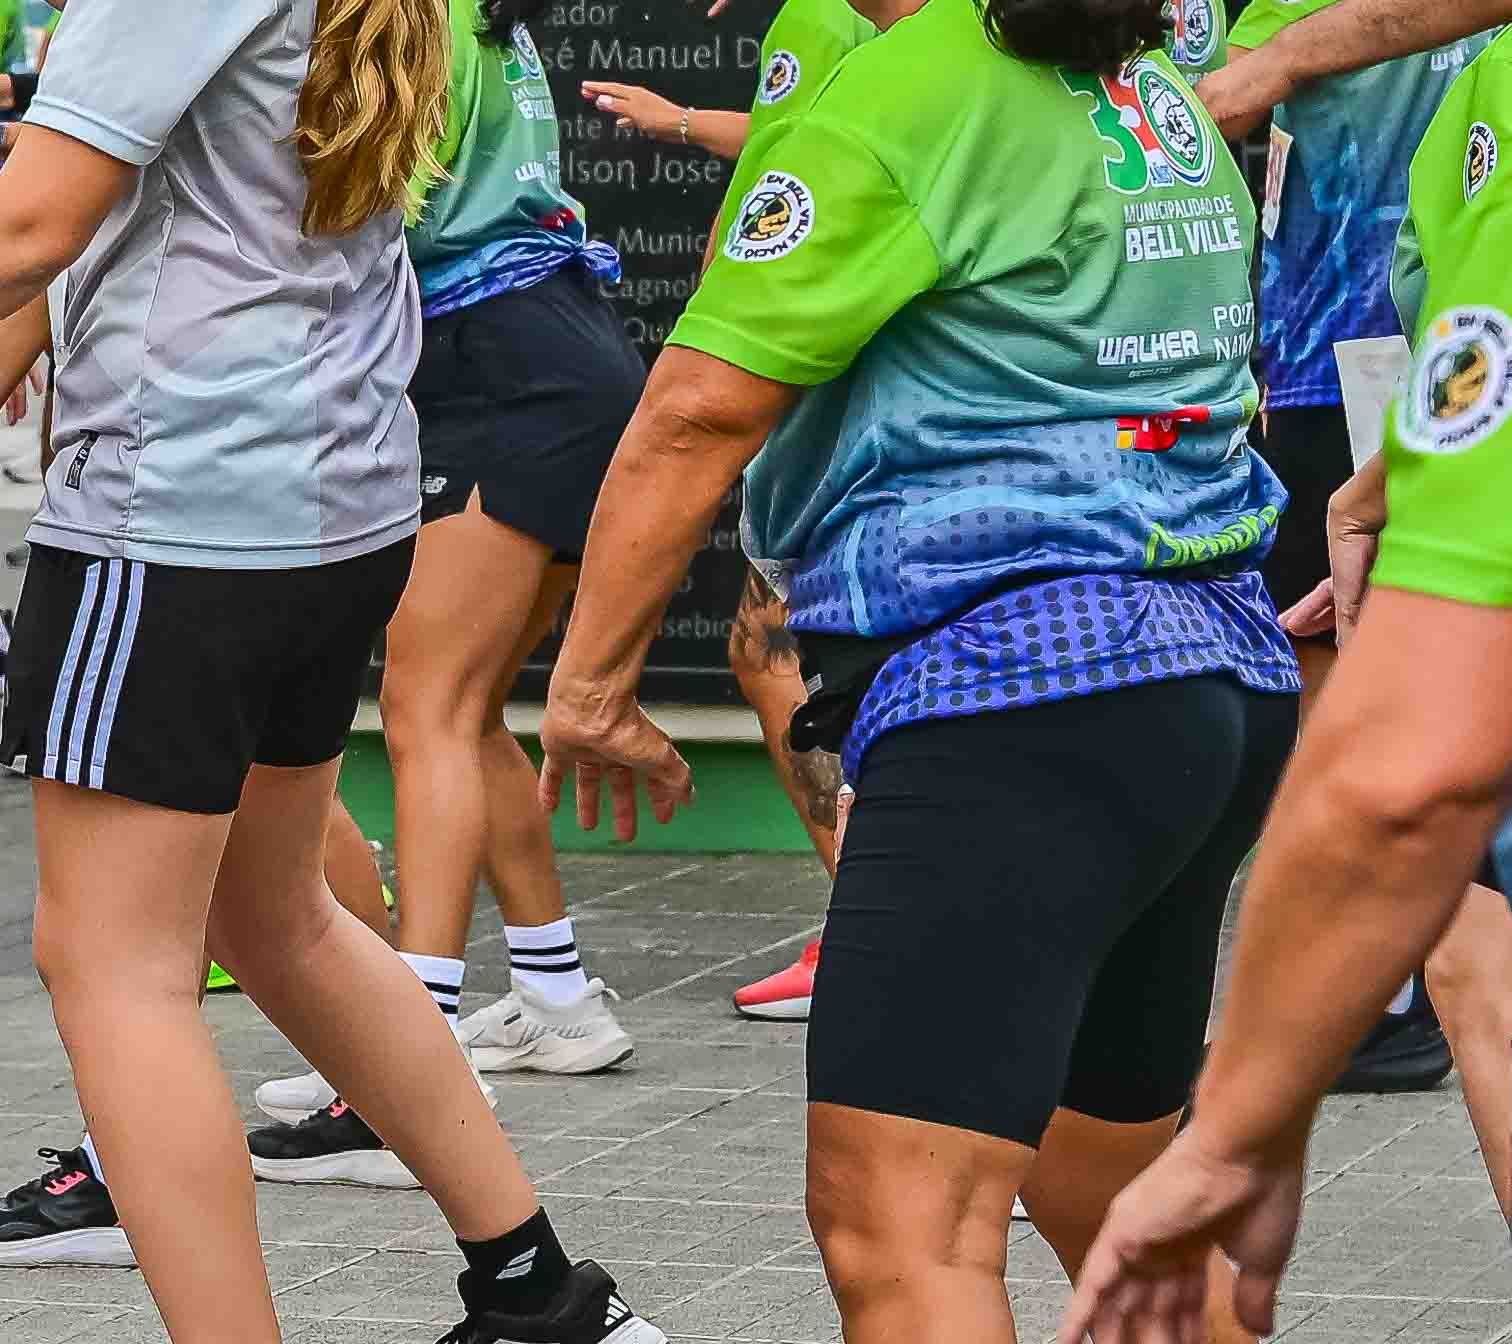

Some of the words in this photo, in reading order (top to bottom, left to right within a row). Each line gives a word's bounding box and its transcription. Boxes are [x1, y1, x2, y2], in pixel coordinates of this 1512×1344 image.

[588, 35, 721, 69] Manuel
[567, 152, 636, 184] lson
[1126, 225, 1185, 263] BELL
[1182, 217, 1242, 255] VILLE
